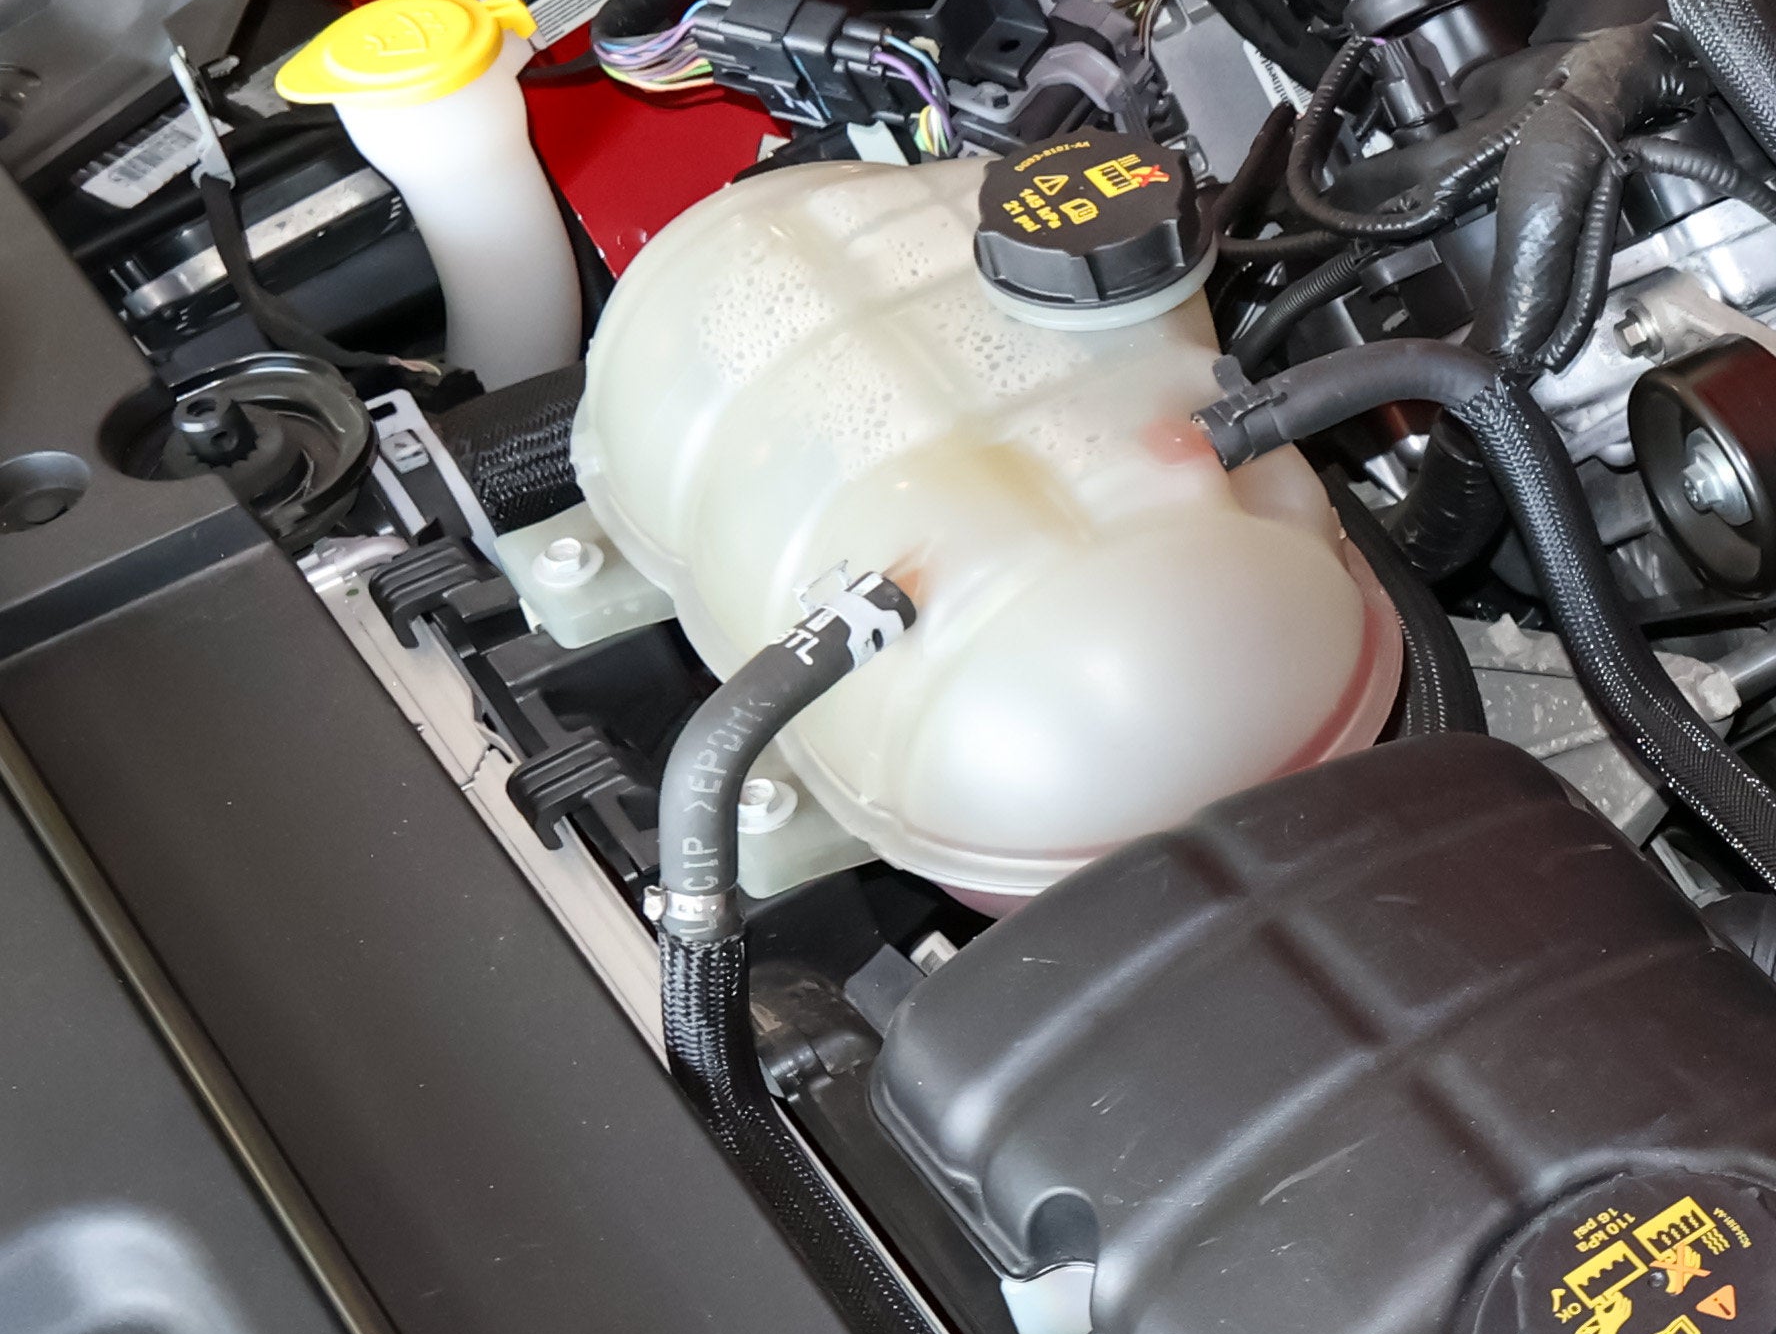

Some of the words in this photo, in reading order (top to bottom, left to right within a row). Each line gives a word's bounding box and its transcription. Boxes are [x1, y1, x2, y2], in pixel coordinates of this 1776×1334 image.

[1596, 1207, 1618, 1225] 16
[1603, 1211, 1636, 1237] 110
[1572, 1217, 1597, 1239] psi
[1575, 1229, 1608, 1253] kPa
[1555, 1301, 1583, 1323] OK
